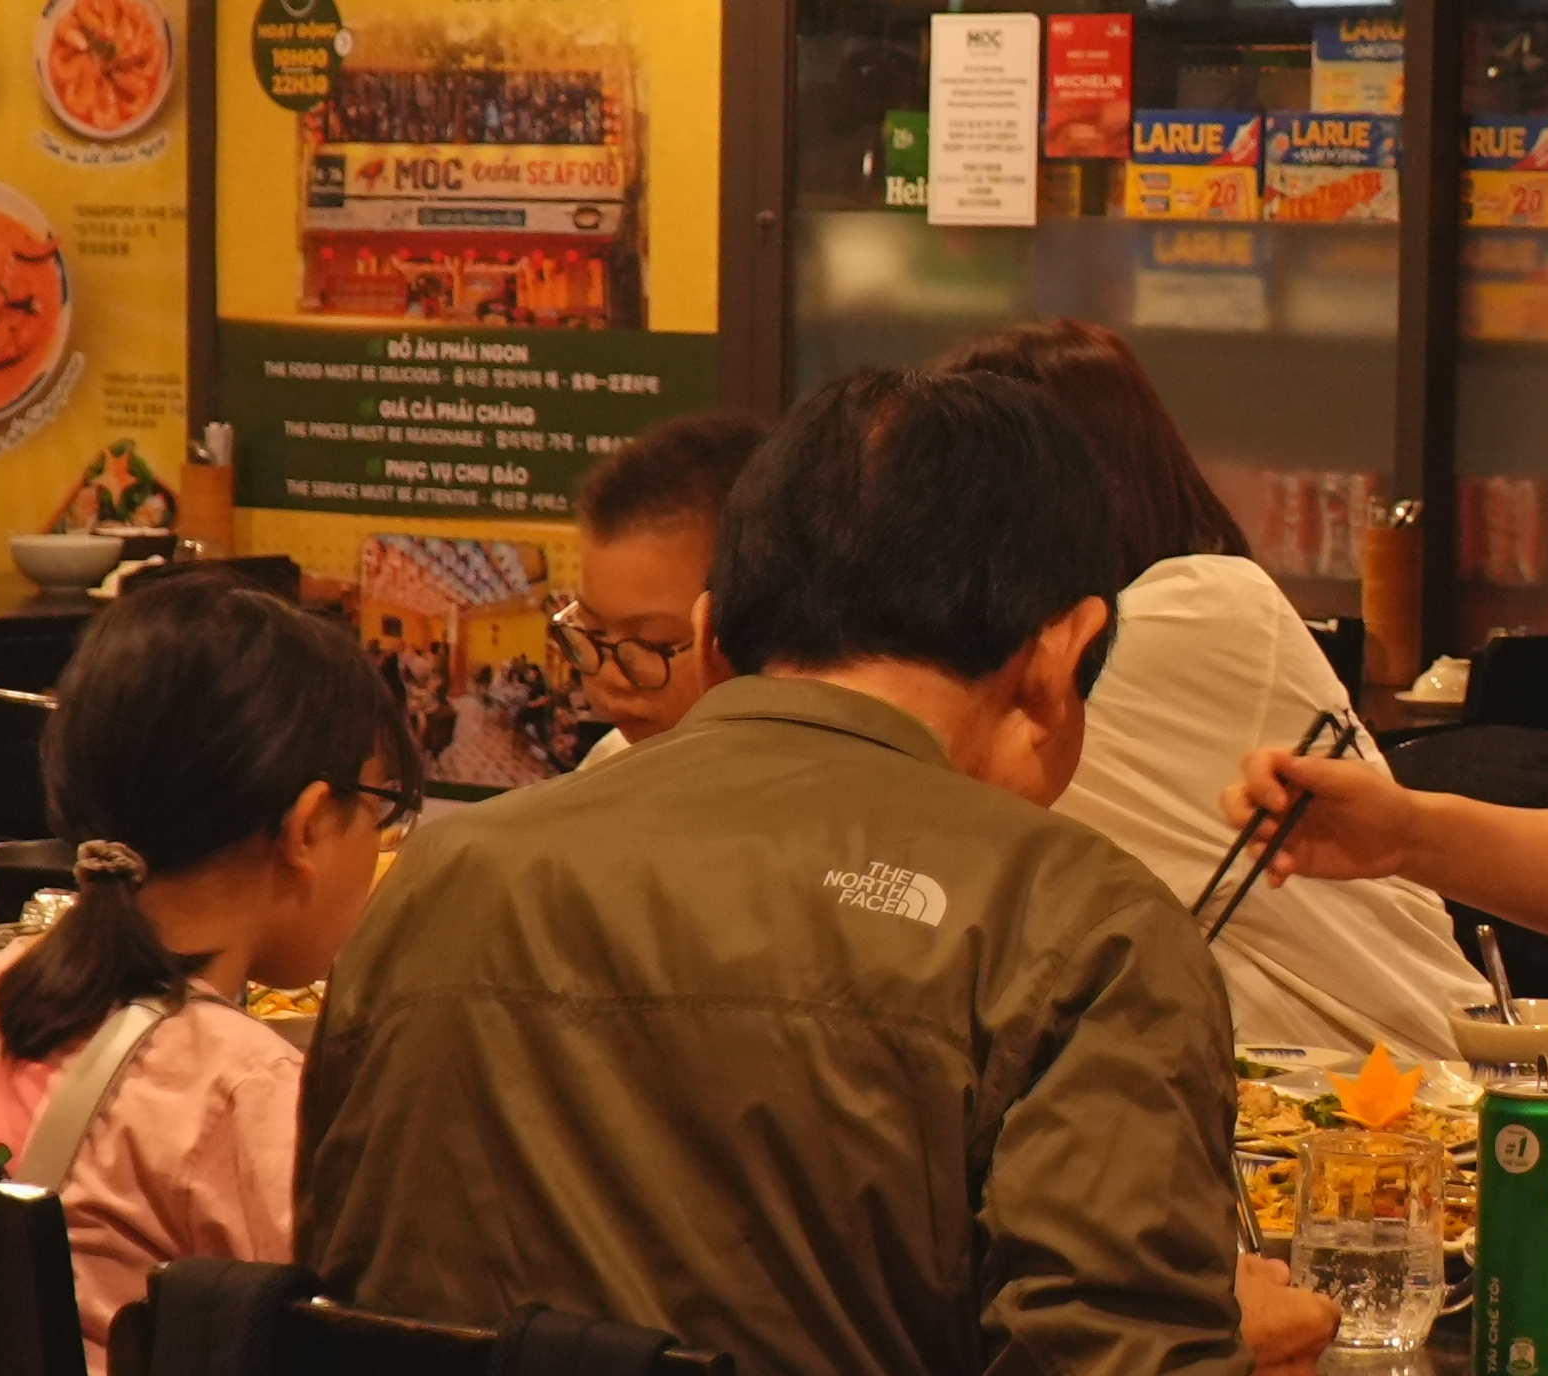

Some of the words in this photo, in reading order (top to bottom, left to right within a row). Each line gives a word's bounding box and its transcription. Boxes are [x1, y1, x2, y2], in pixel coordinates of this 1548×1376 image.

[1133, 122, 1225, 155] LARUE
[1291, 120, 1372, 148] LARUE
[526, 159, 620, 186] SEAFOOD
[361, 364, 378, 382] BE
[386, 426, 403, 443] BE
[396, 485, 413, 503] BE
[823, 870, 906, 899] NORTH
[868, 861, 915, 886] THE
[838, 889, 901, 915] FACE
